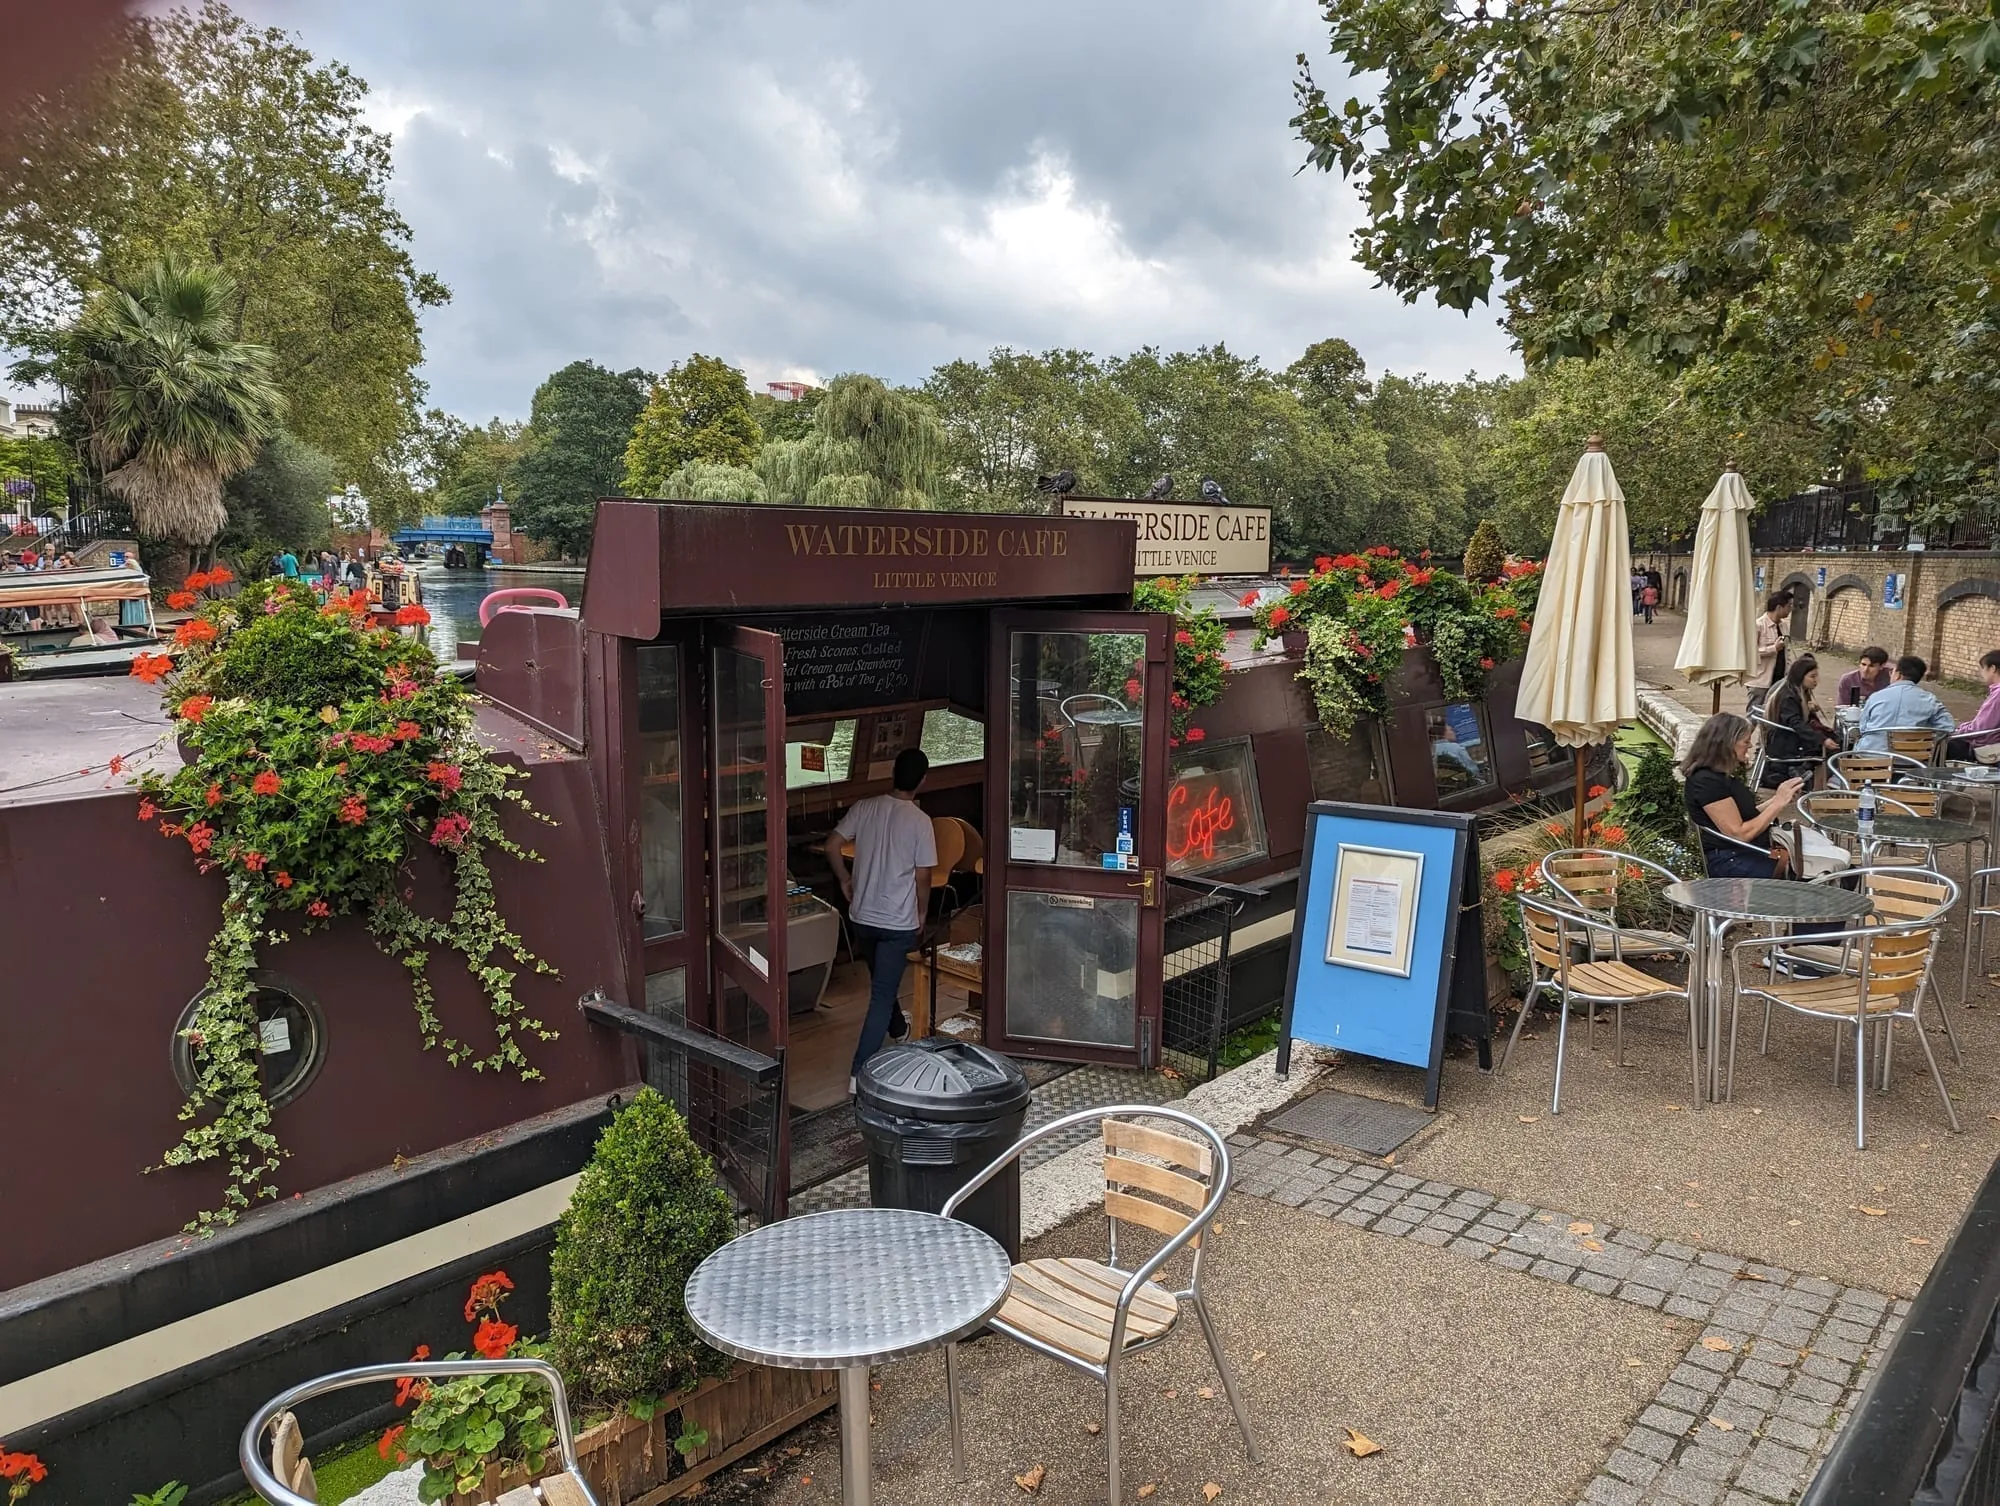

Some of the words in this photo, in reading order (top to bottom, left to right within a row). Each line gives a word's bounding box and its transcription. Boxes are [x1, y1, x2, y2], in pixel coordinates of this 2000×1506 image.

[1068, 510, 1210, 542] ERSIDE
[1216, 514, 1267, 541] CAFE
[784, 524, 988, 557] WATERSIDE
[998, 527, 1068, 557] CAFE
[1135, 550, 1172, 567] ITTLE
[1175, 550, 1217, 566] VENICE
[873, 572, 936, 589] LITTLE
[941, 571, 998, 588] VENICE
[830, 624, 868, 639] Cream
[785, 646, 817, 661] Fresh
[783, 663, 798, 677] eal
[800, 663, 833, 676] Cream
[835, 660, 855, 673] and
[855, 657, 904, 672] Strawberry
[794, 678, 816, 692] with
[825, 673, 844, 689] Pot
[845, 674, 858, 687] of
[858, 673, 876, 685] Tea
[1166, 785, 1234, 858] Cafe
